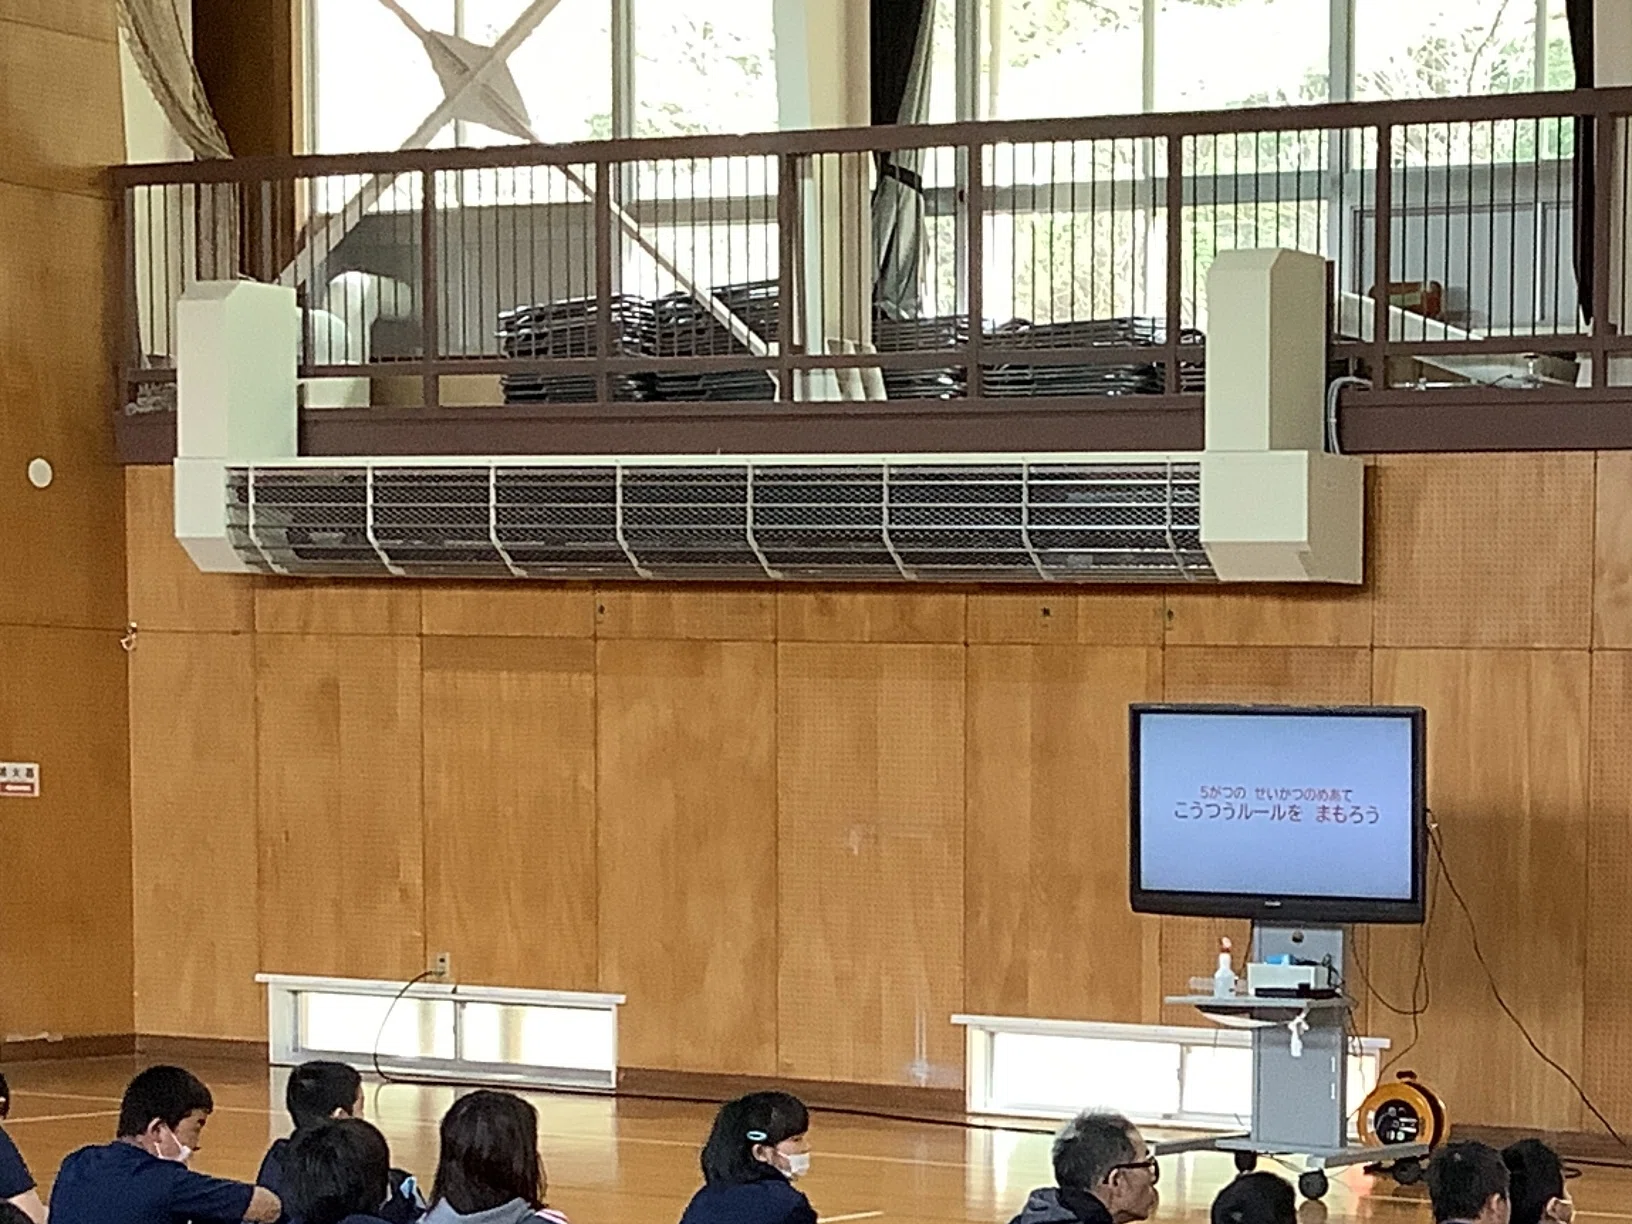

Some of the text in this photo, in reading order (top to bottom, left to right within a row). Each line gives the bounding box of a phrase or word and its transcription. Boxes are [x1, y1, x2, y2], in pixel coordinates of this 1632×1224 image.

[1200, 785, 1353, 801] 5がつの せいかつのめあて
[1174, 801, 1380, 824] こうつうルールを まもろう
